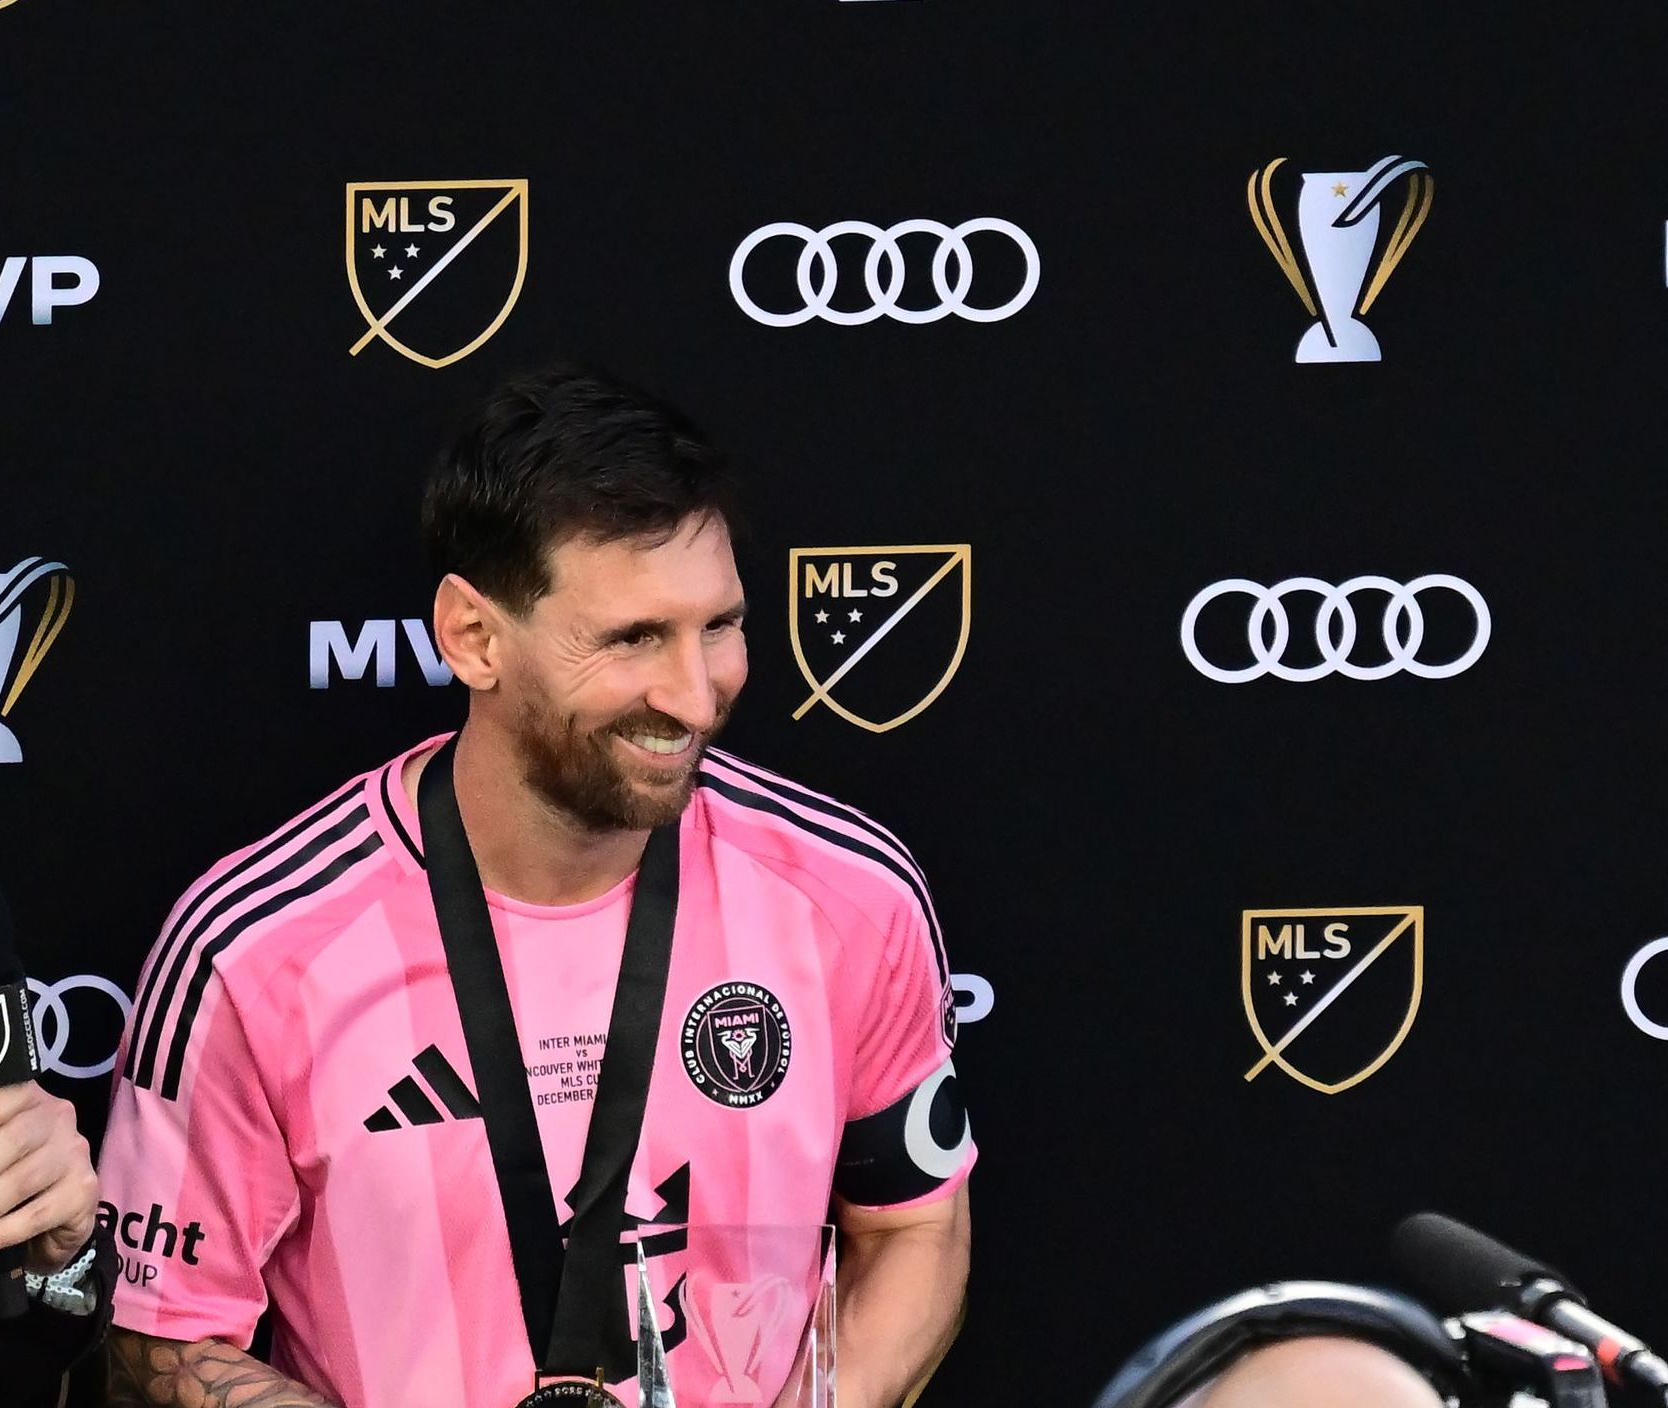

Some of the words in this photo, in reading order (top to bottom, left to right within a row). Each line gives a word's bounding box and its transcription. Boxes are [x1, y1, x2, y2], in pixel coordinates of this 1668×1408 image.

[362, 195, 456, 234] MLS
[805, 560, 899, 599] MLS
[309, 618, 454, 689] MV
[1257, 922, 1352, 961] MLS
[714, 1013, 760, 1029] MIAMI
[538, 1036, 570, 1051] INTER
[573, 1033, 607, 1047] MIAMI
[526, 1062, 574, 1078] NCOUVER
[560, 1075, 583, 1089] MLS
[537, 1088, 594, 1106] DECEMBER
[95, 1200, 206, 1266] acht
